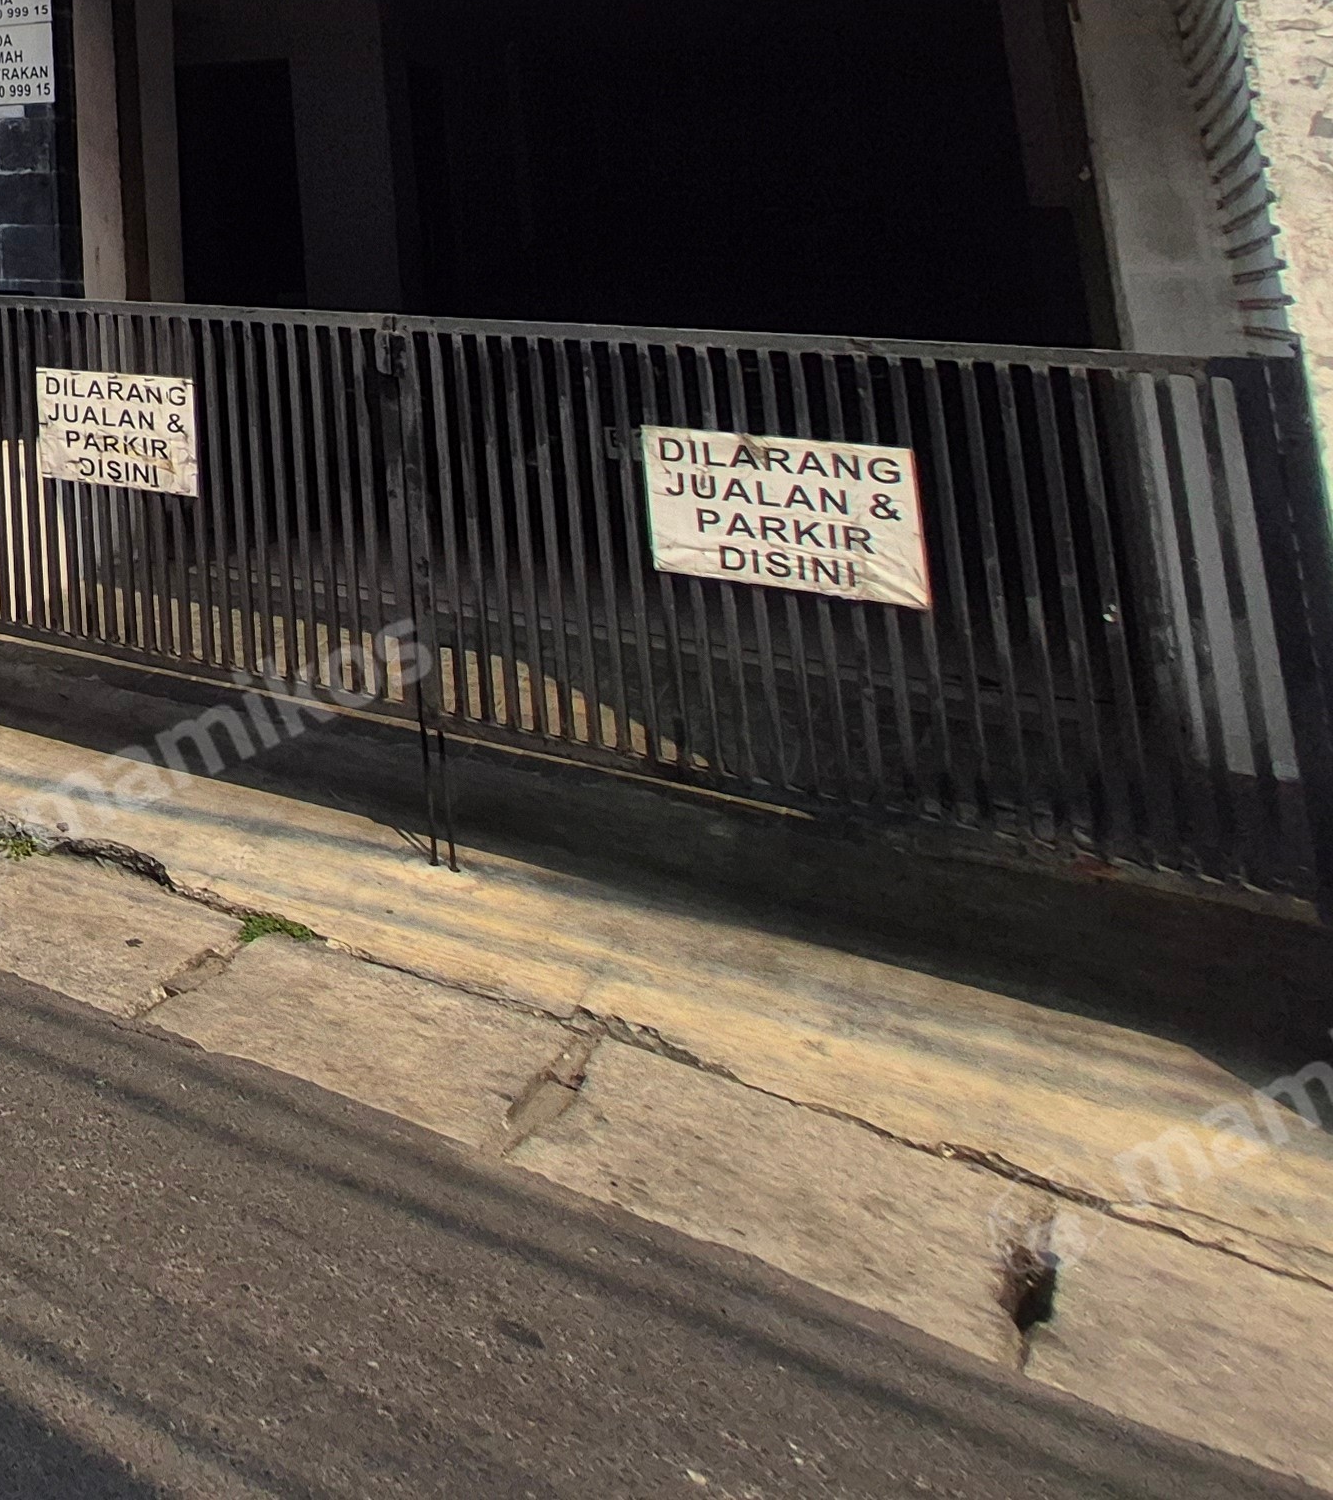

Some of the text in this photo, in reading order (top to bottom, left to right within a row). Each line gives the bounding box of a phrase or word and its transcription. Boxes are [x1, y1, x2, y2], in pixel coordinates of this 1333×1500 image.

[7, 7, 29, 19] 999
[35, 4, 49, 16] 15
[9, 84, 31, 97] 999
[36, 83, 51, 96] 15
[44, 376, 187, 407] DILARANG
[48, 403, 186, 434] JUALAN &
[66, 430, 169, 460] PARKIR
[657, 436, 903, 485] DILARANG
[78, 457, 161, 488] DISINI
[664, 471, 902, 522] JUALAN &
[695, 506, 876, 555] PARKIR
[718, 544, 857, 588] DISINI
